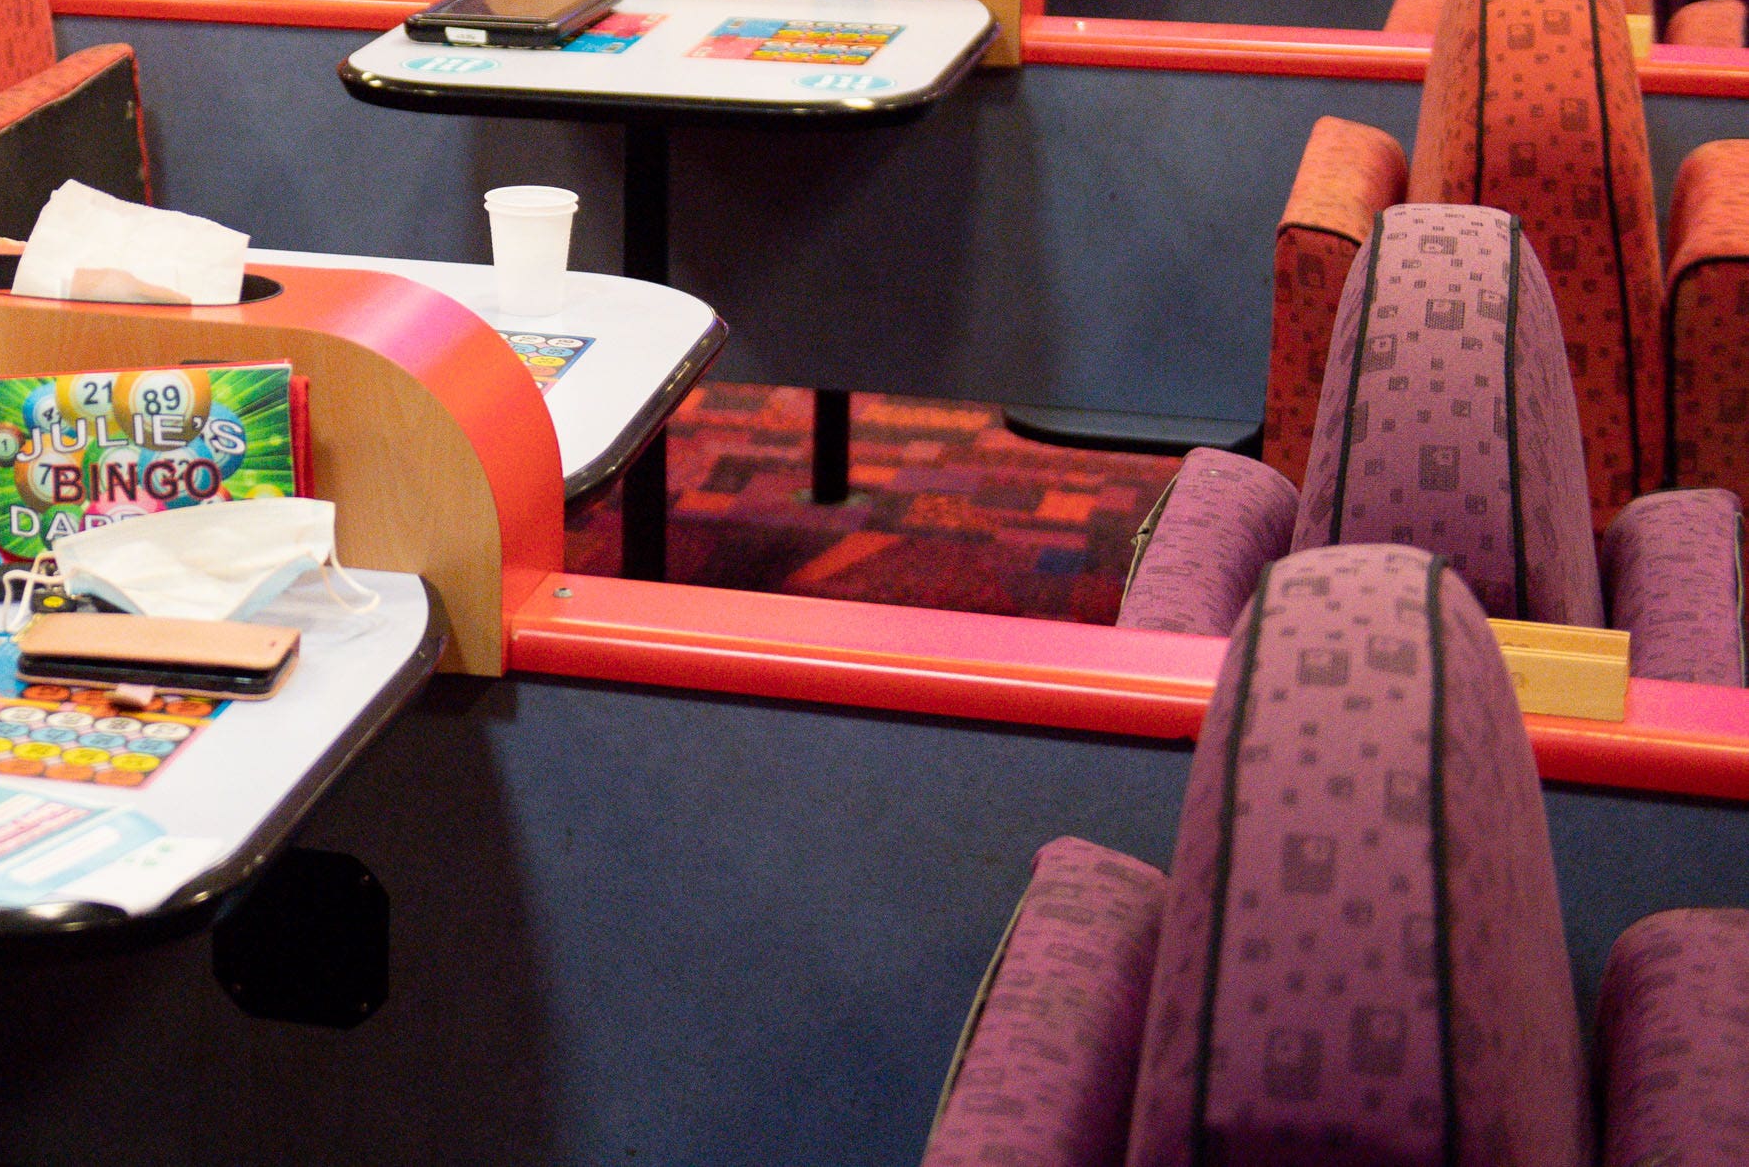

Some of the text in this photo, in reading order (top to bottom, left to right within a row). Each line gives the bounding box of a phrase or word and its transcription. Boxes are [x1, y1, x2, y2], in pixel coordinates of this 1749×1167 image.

[83, 380, 113, 405] 21
[143, 385, 181, 414] 89
[16, 413, 247, 462] JULIE'S
[51, 458, 223, 503] BINGO
